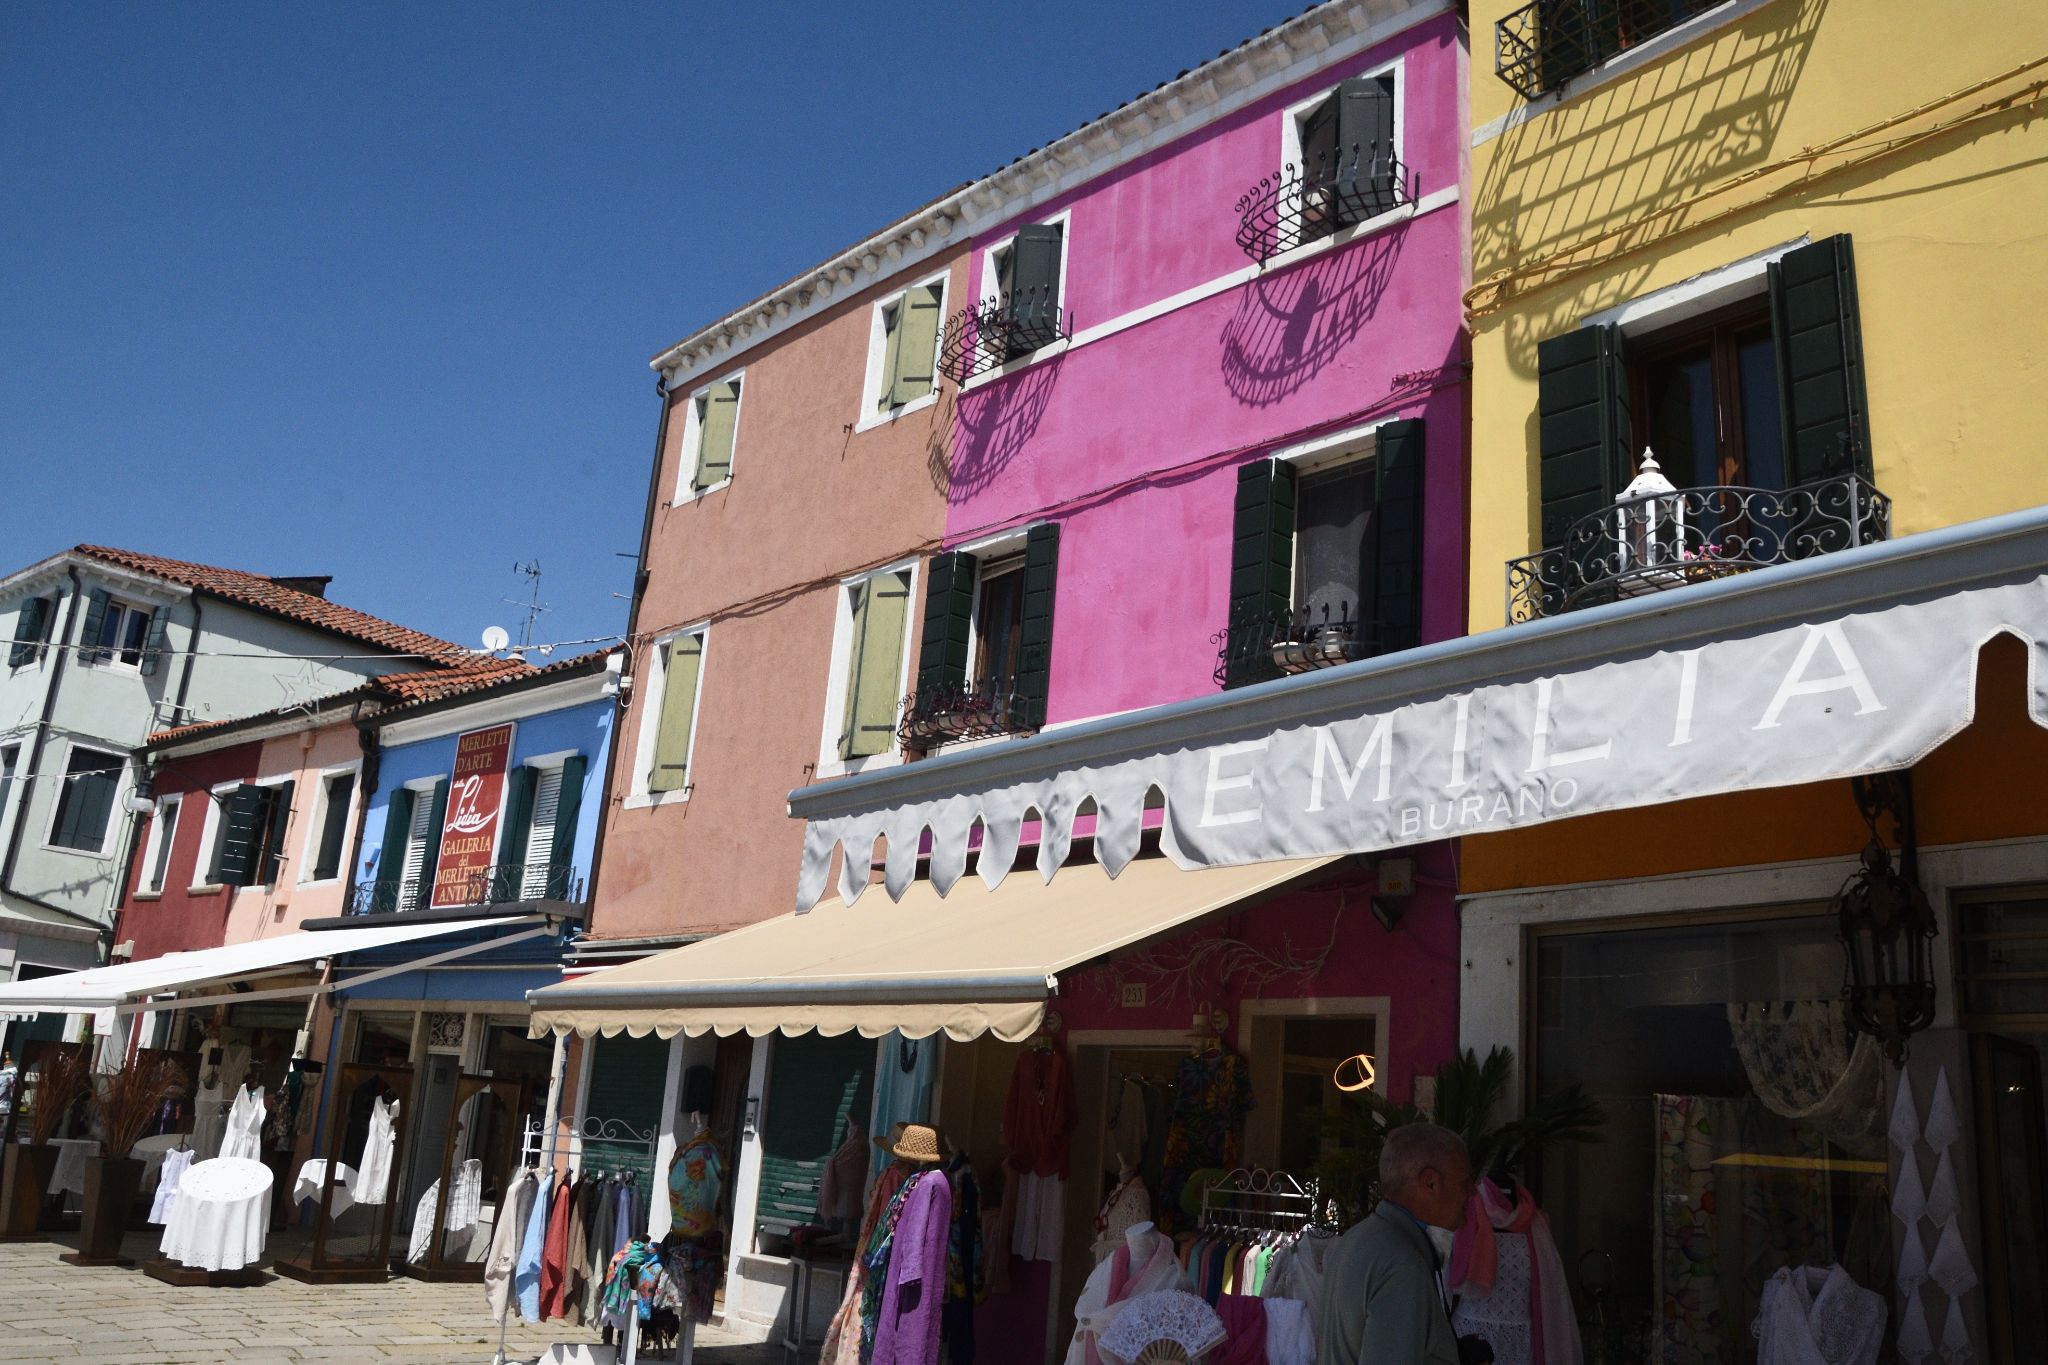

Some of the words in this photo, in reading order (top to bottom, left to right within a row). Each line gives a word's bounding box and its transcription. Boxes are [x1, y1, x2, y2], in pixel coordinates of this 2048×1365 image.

[1197, 619, 1888, 829] EMILIA
[460, 728, 509, 753] MERLETTI
[456, 751, 493, 773] D'ARTE
[446, 774, 499, 833] Lidia
[1400, 777, 1578, 837] BURANO
[442, 836, 492, 856] GALLERIA
[458, 854, 469, 867] del
